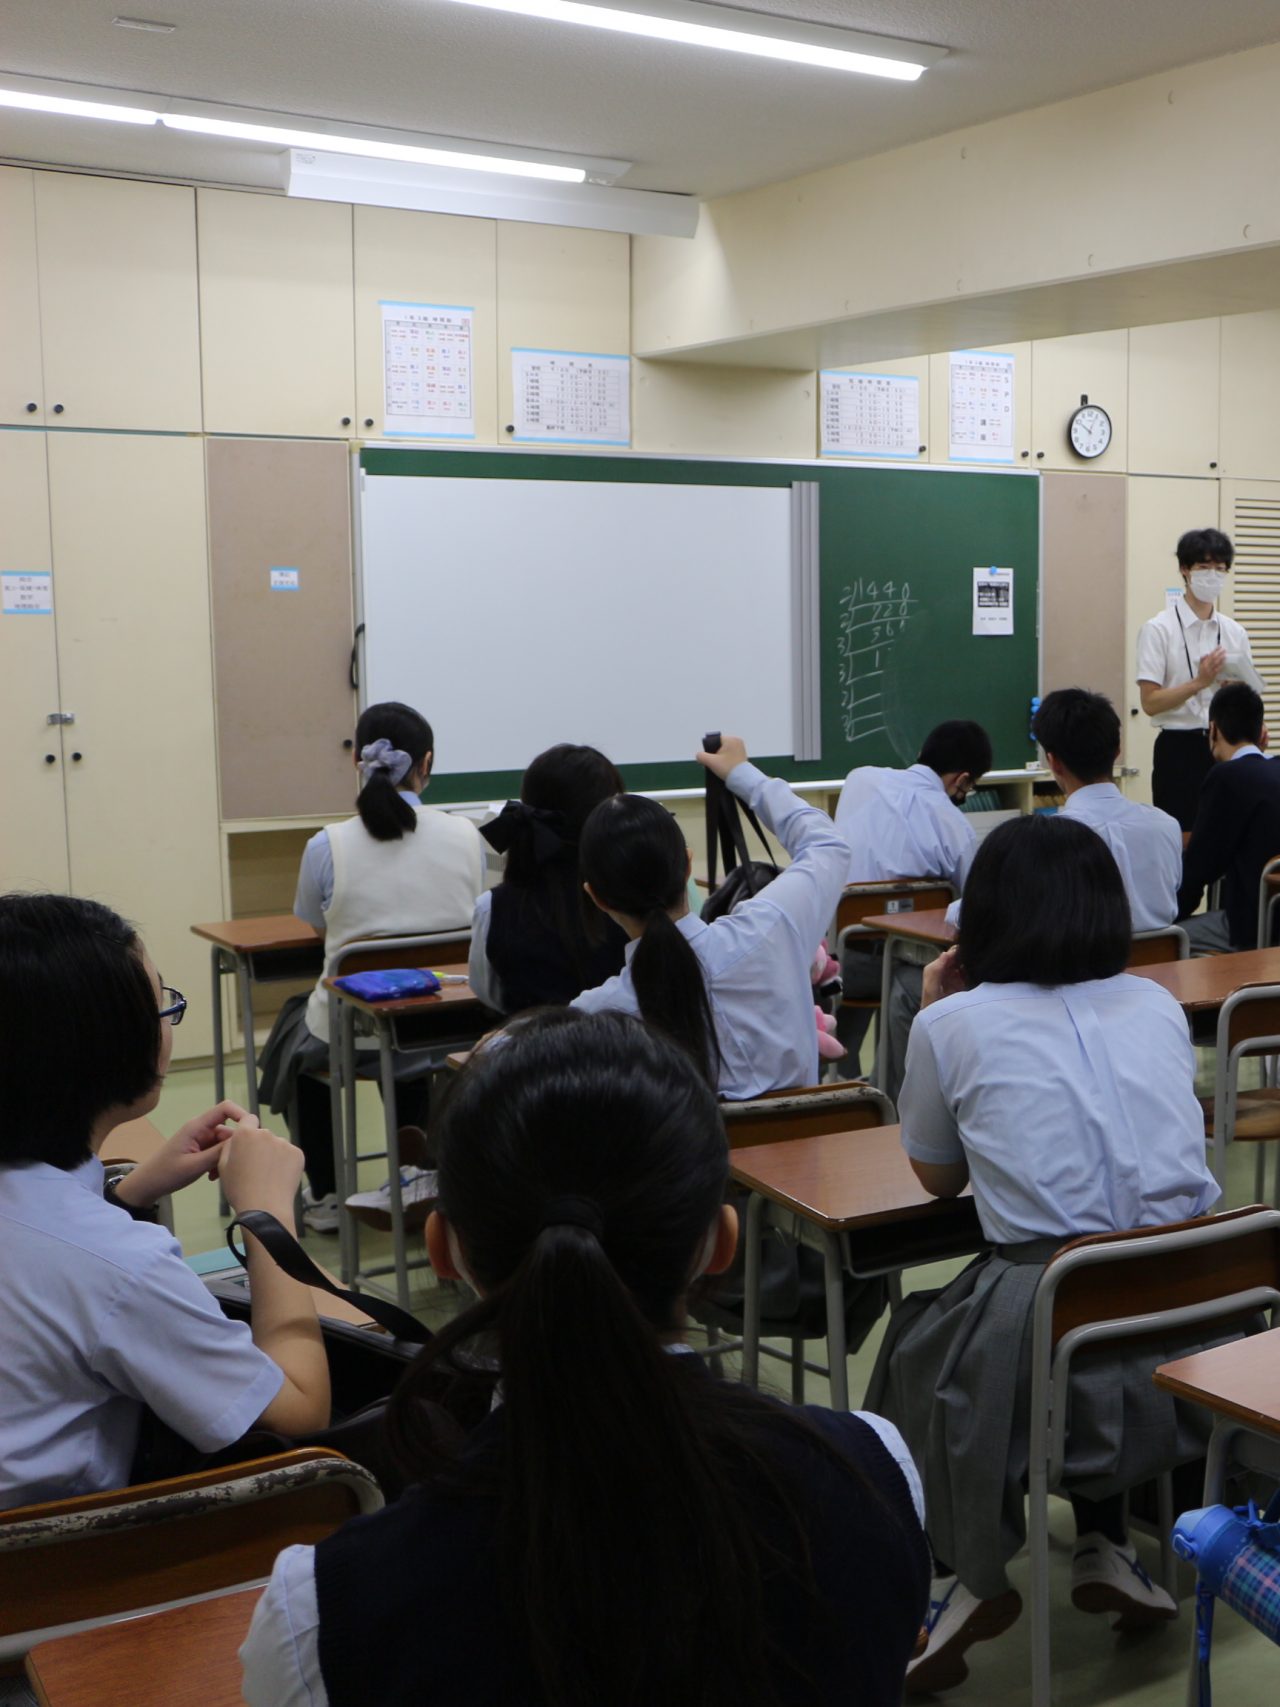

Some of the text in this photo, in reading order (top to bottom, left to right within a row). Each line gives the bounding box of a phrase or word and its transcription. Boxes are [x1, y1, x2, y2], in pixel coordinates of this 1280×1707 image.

[858, 576, 911, 601] 1440
[872, 602, 909, 622] 720
[836, 636, 846, 655] 3
